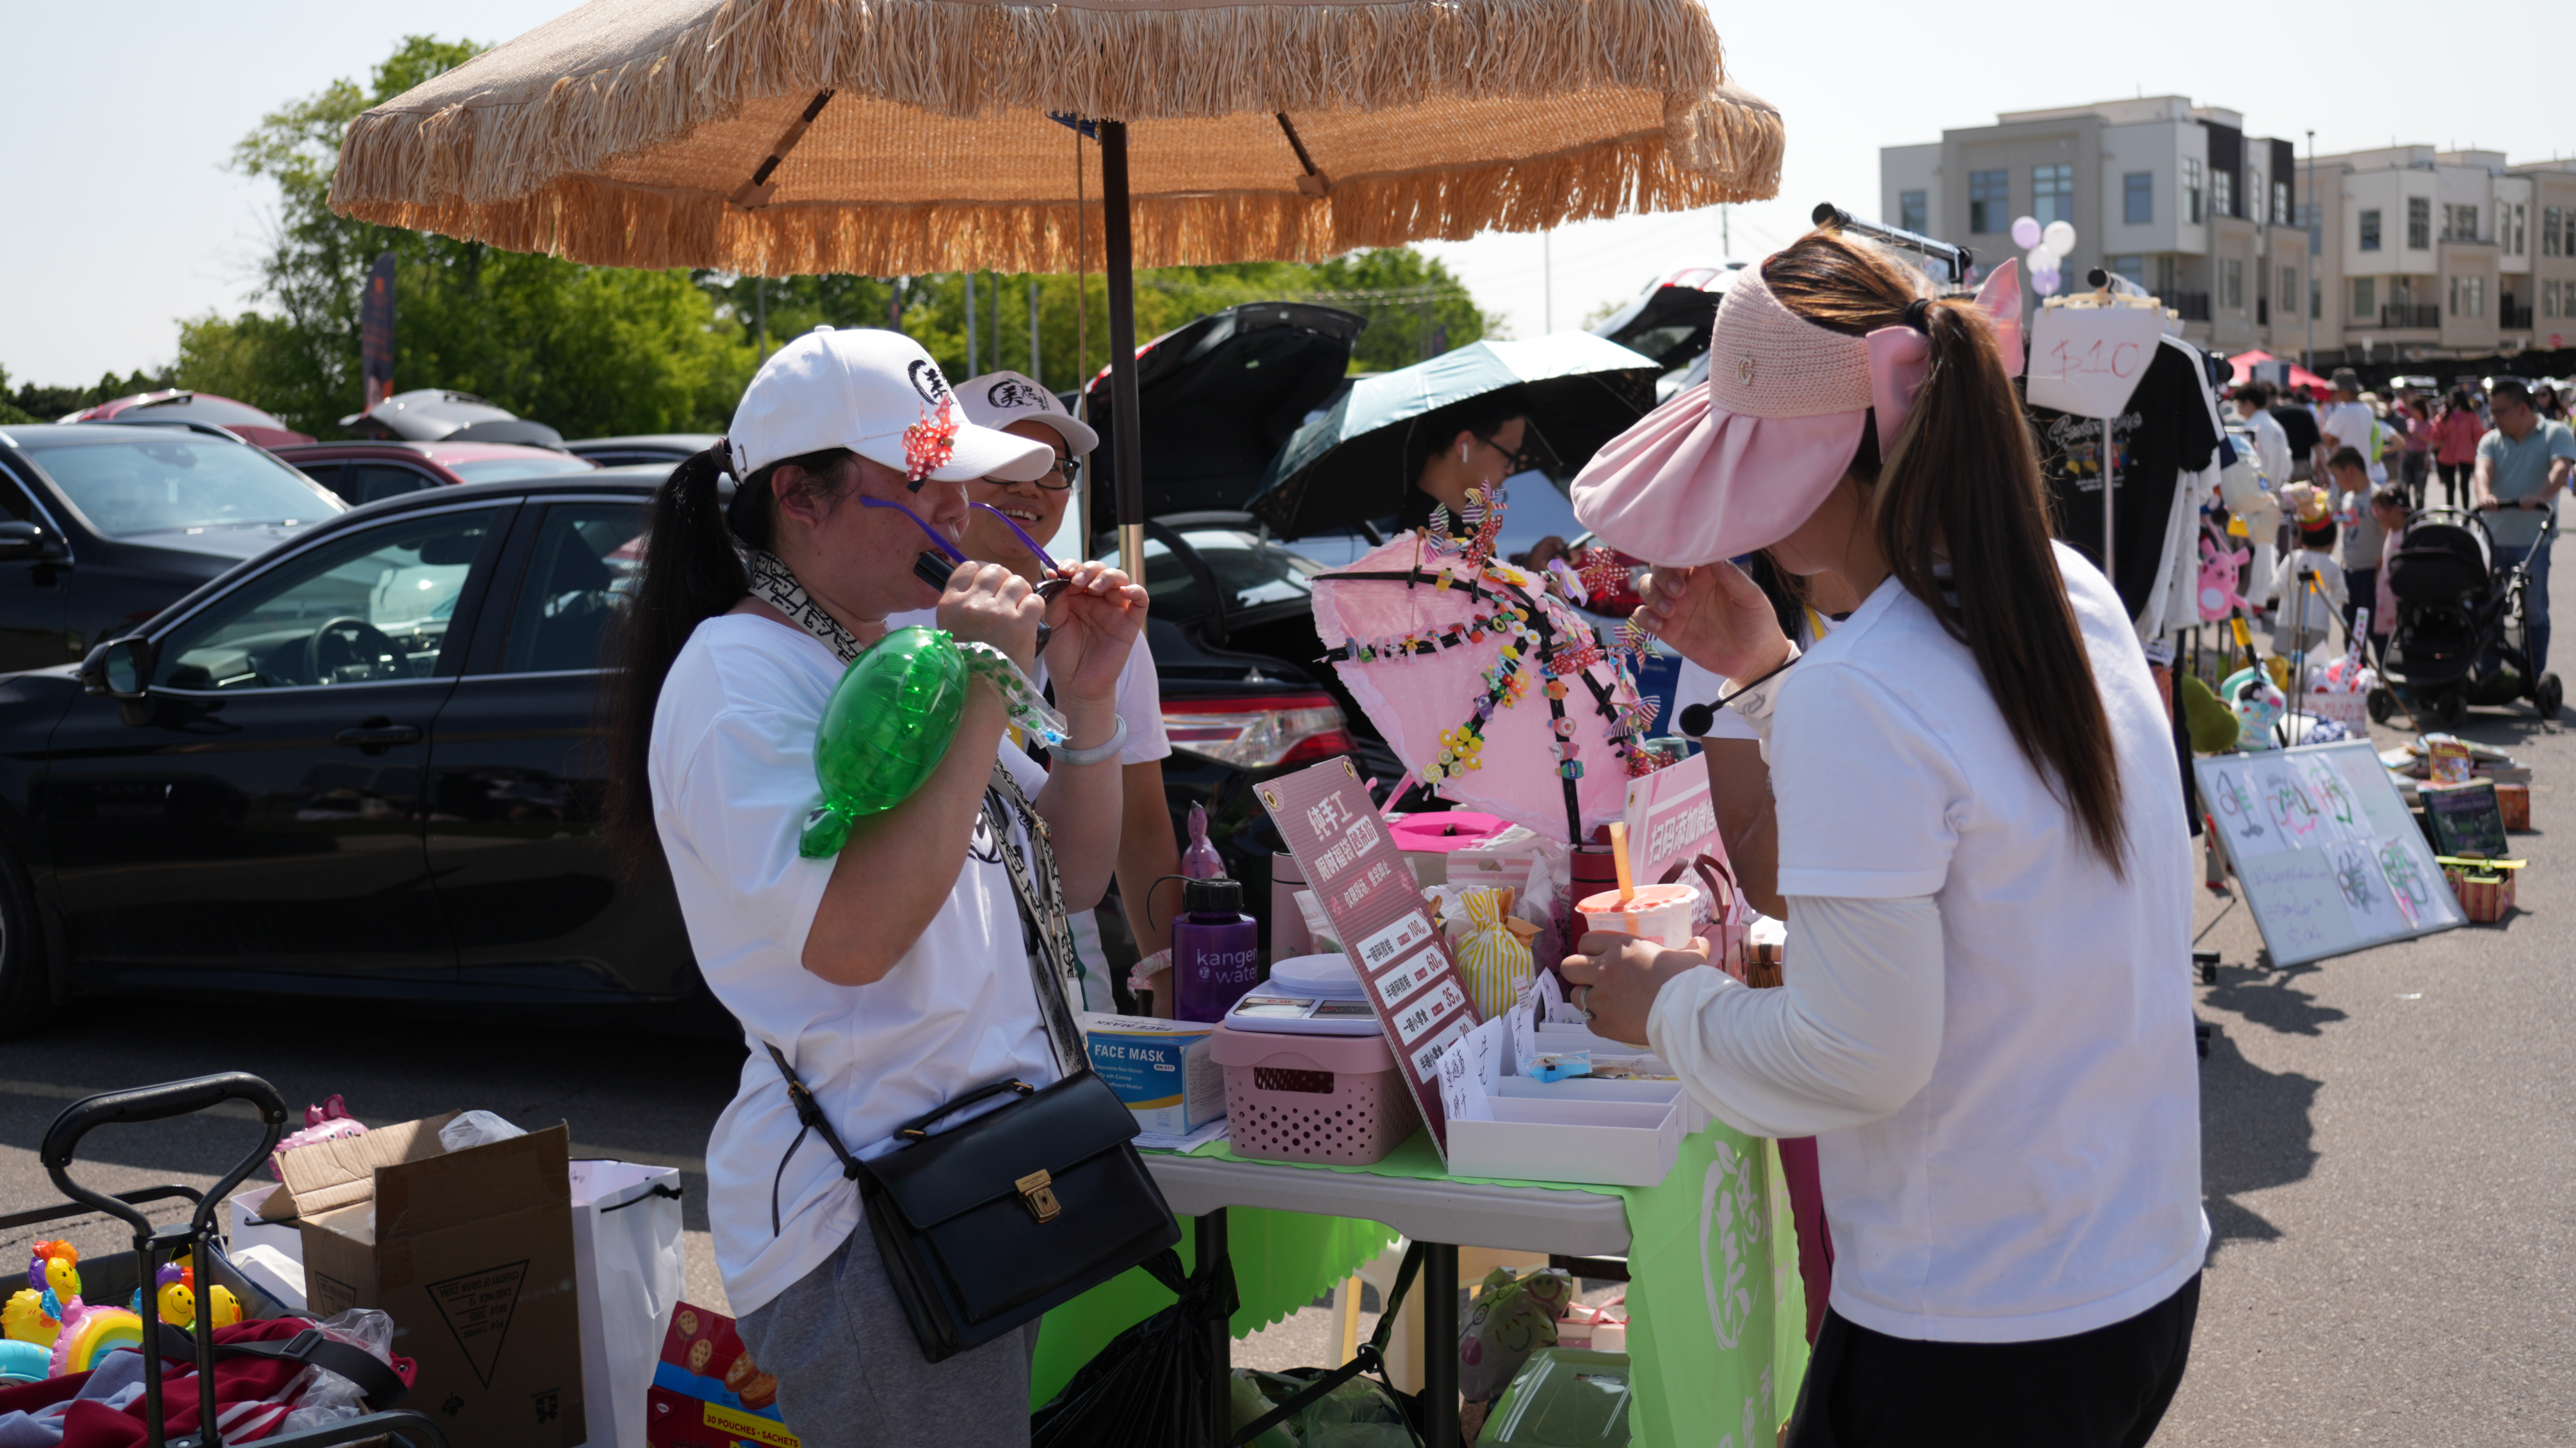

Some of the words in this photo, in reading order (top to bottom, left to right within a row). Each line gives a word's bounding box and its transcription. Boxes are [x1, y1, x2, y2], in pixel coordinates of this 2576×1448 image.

[2050, 338, 2140, 382] $10
[1306, 790, 1353, 842] 纯手工
[1649, 799, 1717, 866] 扫码添加微信
[1315, 837, 1355, 882] 限时福袋
[1349, 820, 1377, 852] 秒杀价
[1407, 920, 1422, 937] 100
[1197, 947, 1257, 968] kangen
[1426, 952, 1439, 972] 60
[1215, 966, 1257, 984] water
[1404, 1009, 1429, 1032] 一磅小零食
[1442, 987, 1456, 1007] 35
[1095, 1044, 1125, 1059] FACE
[1129, 1047, 1165, 1063] MASK
[462, 1280, 483, 1292] ORIGIN
[483, 1279, 491, 1287] OF
[491, 1271, 519, 1284] COUNTRY
[441, 1287, 459, 1297] CHINA
[479, 1293, 496, 1303] PACK
[495, 1288, 511, 1299] CASE
[495, 1305, 507, 1313] SKU
[706, 1414, 716, 1424] 30
[718, 1418, 756, 1436] POUCHES
[762, 1431, 798, 1448] SACHETS
